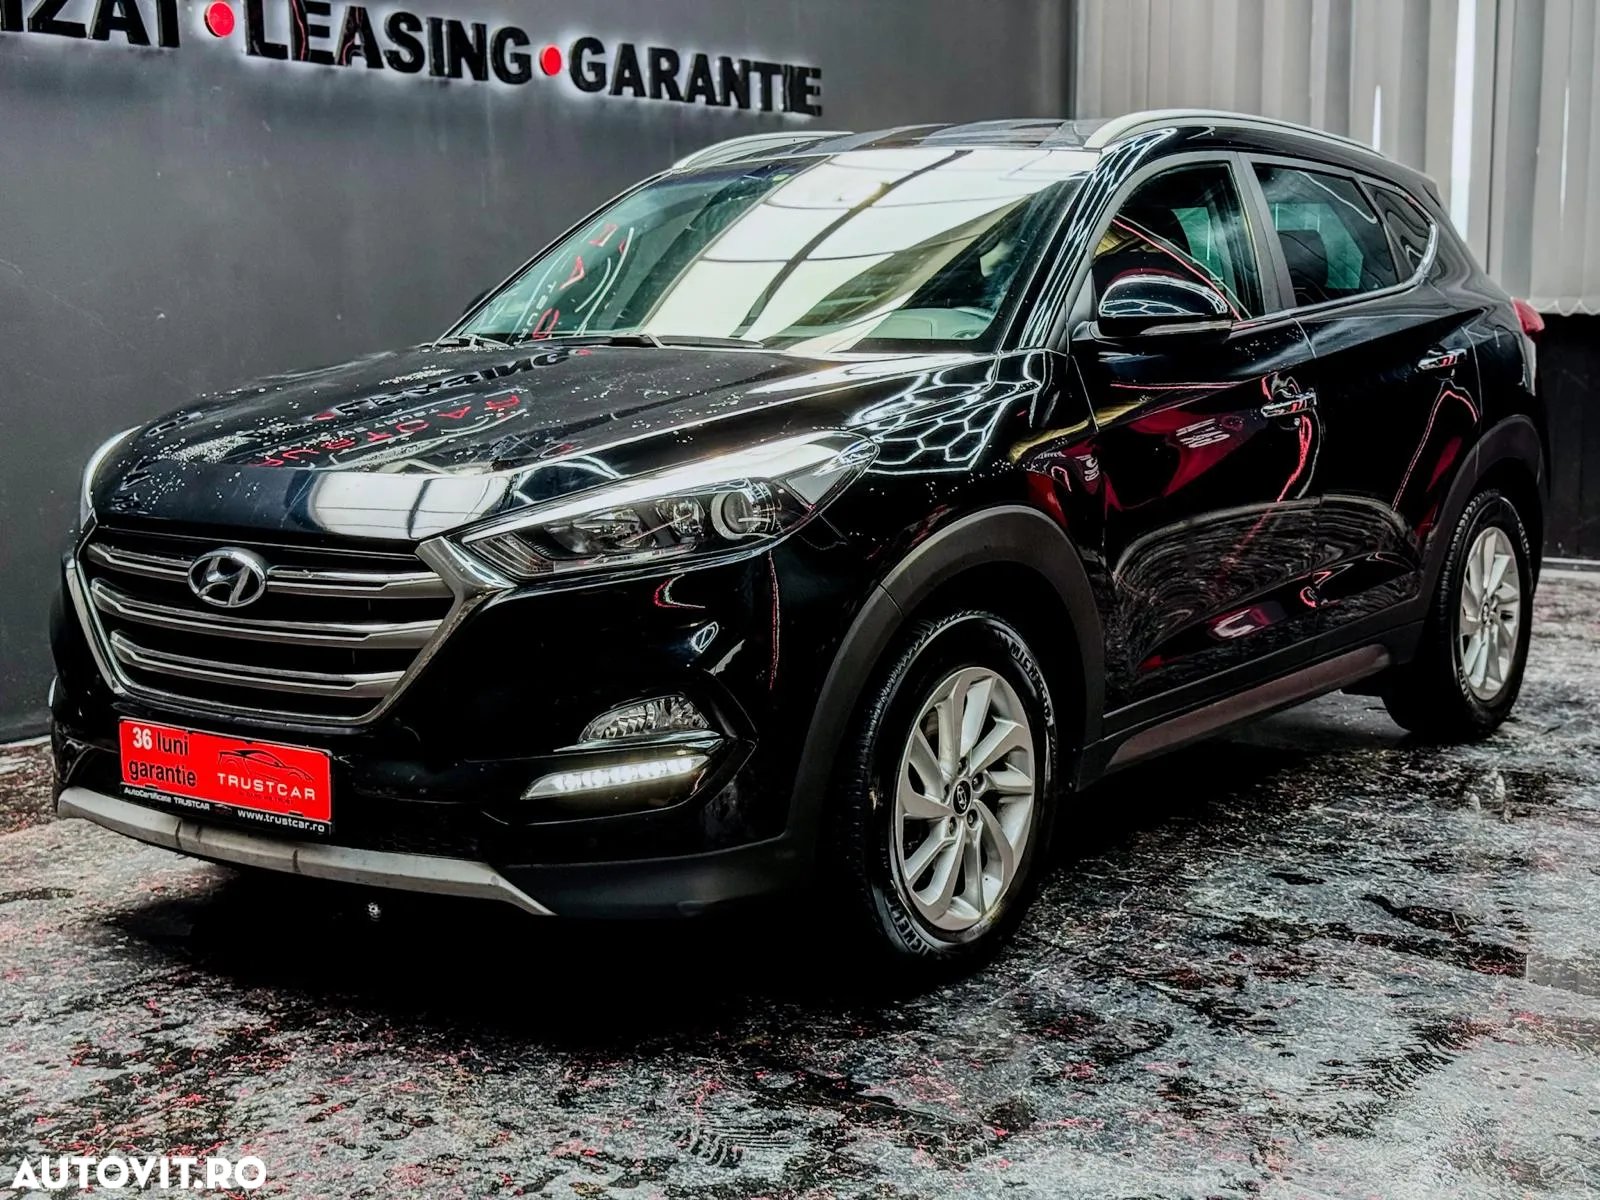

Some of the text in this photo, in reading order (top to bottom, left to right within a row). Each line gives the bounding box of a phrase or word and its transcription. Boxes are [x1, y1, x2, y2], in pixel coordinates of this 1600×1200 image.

[245, 0, 532, 85] LEASING
[568, 36, 822, 117] GARANTIE
[132, 727, 190, 756] 36 luni
[129, 759, 198, 787] garantie
[217, 773, 316, 800] TRUSTCAR
[173, 797, 210, 811] TRUSTCAR
[237, 809, 325, 833] www.trustcar.ro
